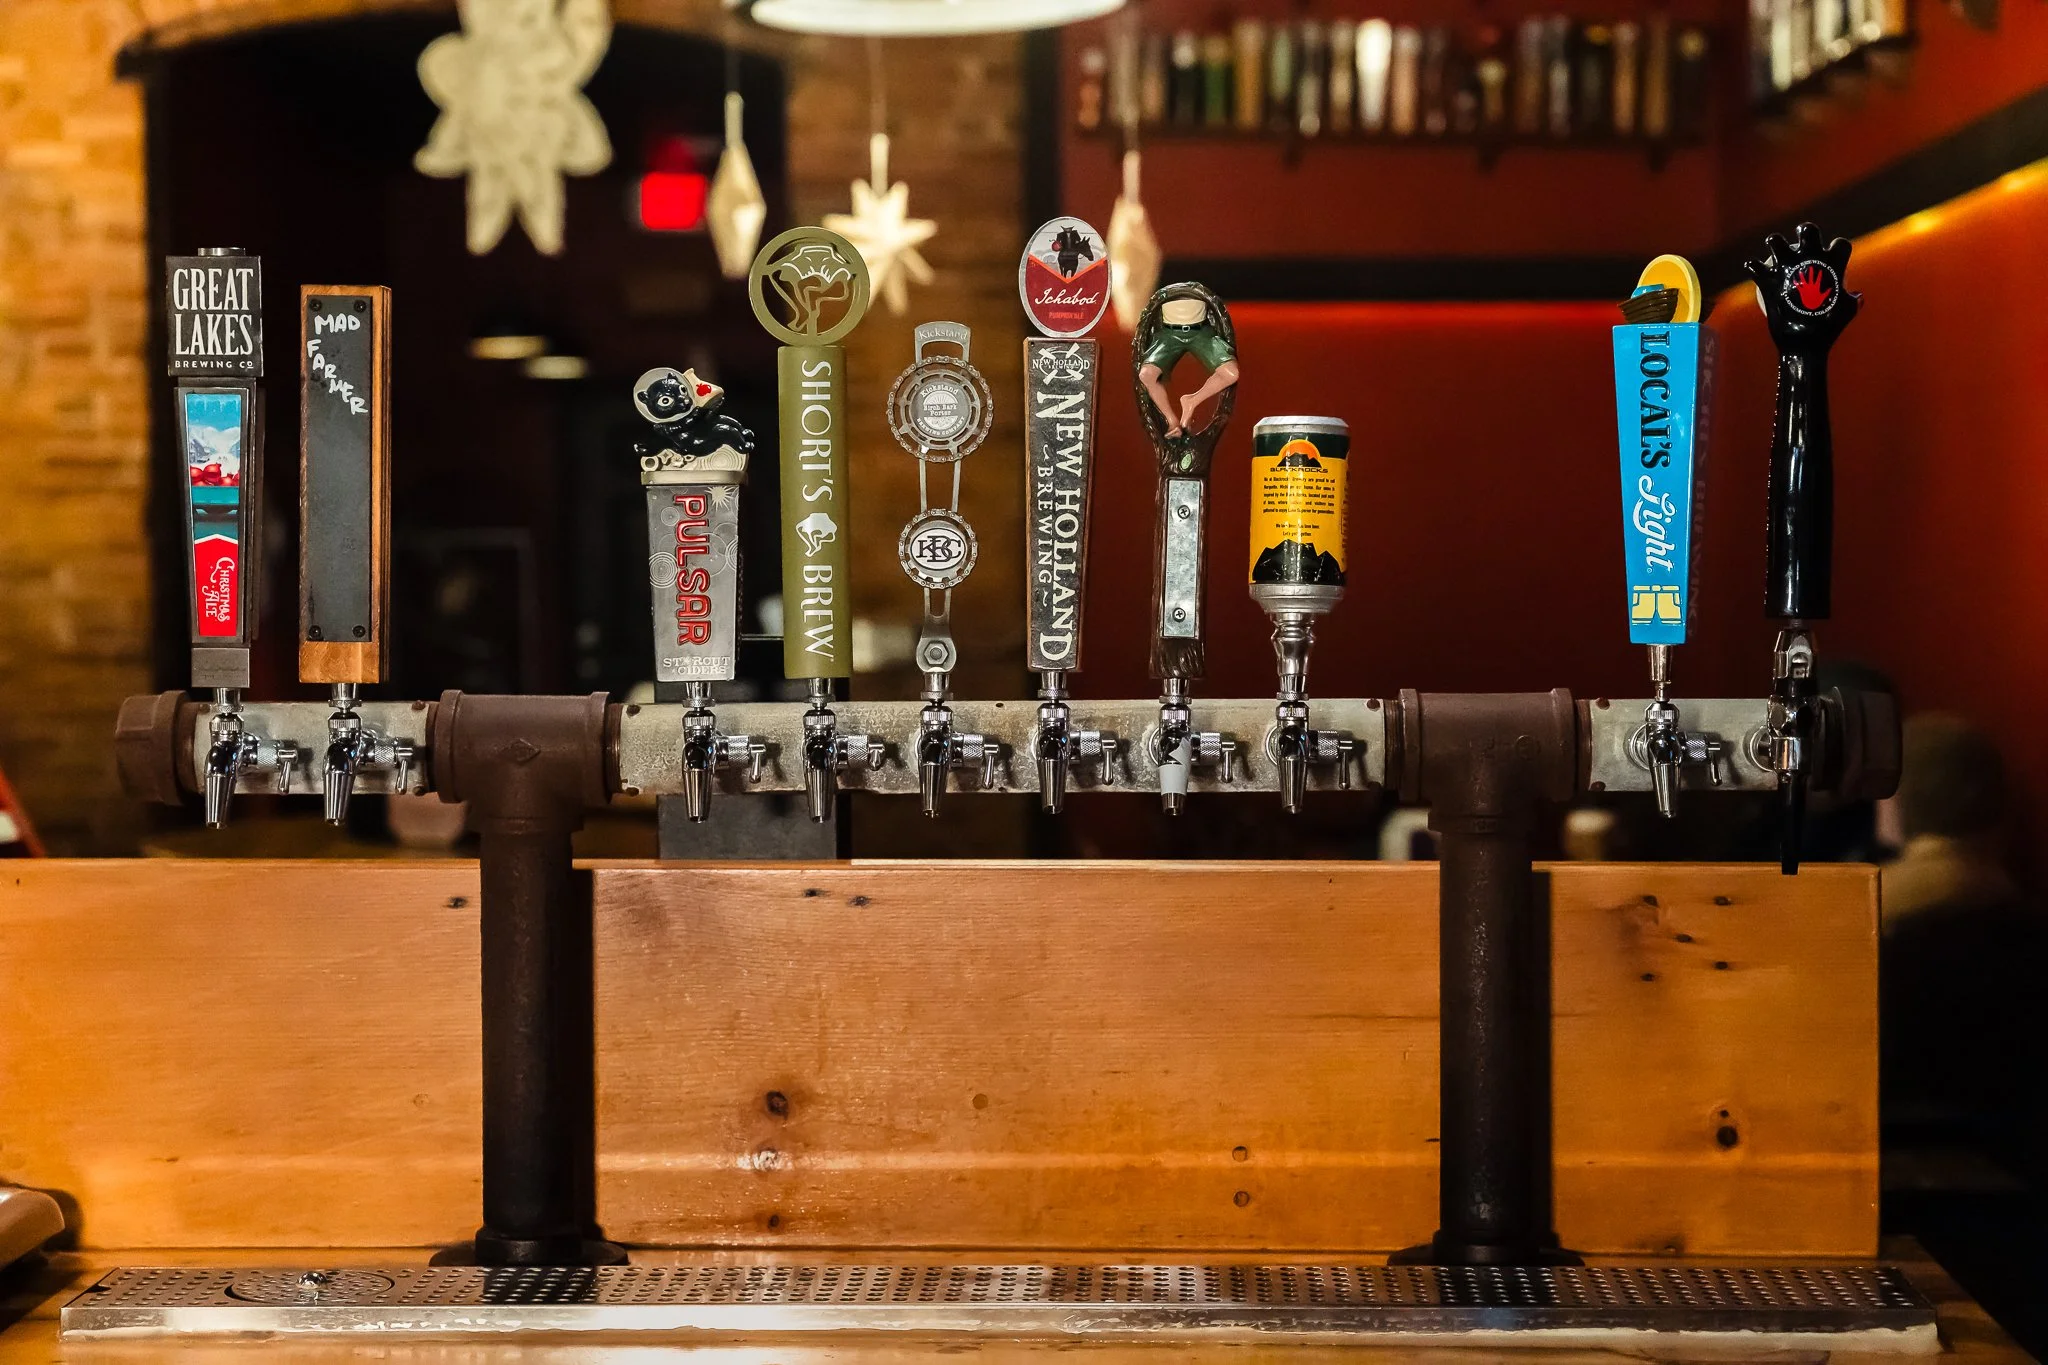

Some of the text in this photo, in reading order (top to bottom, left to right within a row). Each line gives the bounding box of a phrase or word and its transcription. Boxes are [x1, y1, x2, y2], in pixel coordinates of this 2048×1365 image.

[173, 268, 254, 310] GREAT
[1826, 266, 1839, 293] COMPANY
[1035, 287, 1100, 305] Ichabod
[1814, 297, 1839, 316] COLORADO
[174, 313, 253, 356] LAKES
[314, 313, 361, 335] MAD
[918, 328, 968, 340] Kickstand
[174, 360, 233, 369] BREWING
[1053, 359, 1090, 370] HOLLAND
[307, 339, 369, 415] FARMER
[920, 384, 959, 398] Kickstand
[941, 416, 965, 436] COMPANY
[1633, 331, 1677, 573] LOCAL'S Light
[799, 359, 834, 658] SHORT'S BREW
[1036, 391, 1085, 660] NEW HOLLAND
[1037, 466, 1054, 582] BREWING
[673, 494, 712, 647] PULSAR
[677, 665, 727, 675] CIDERS
